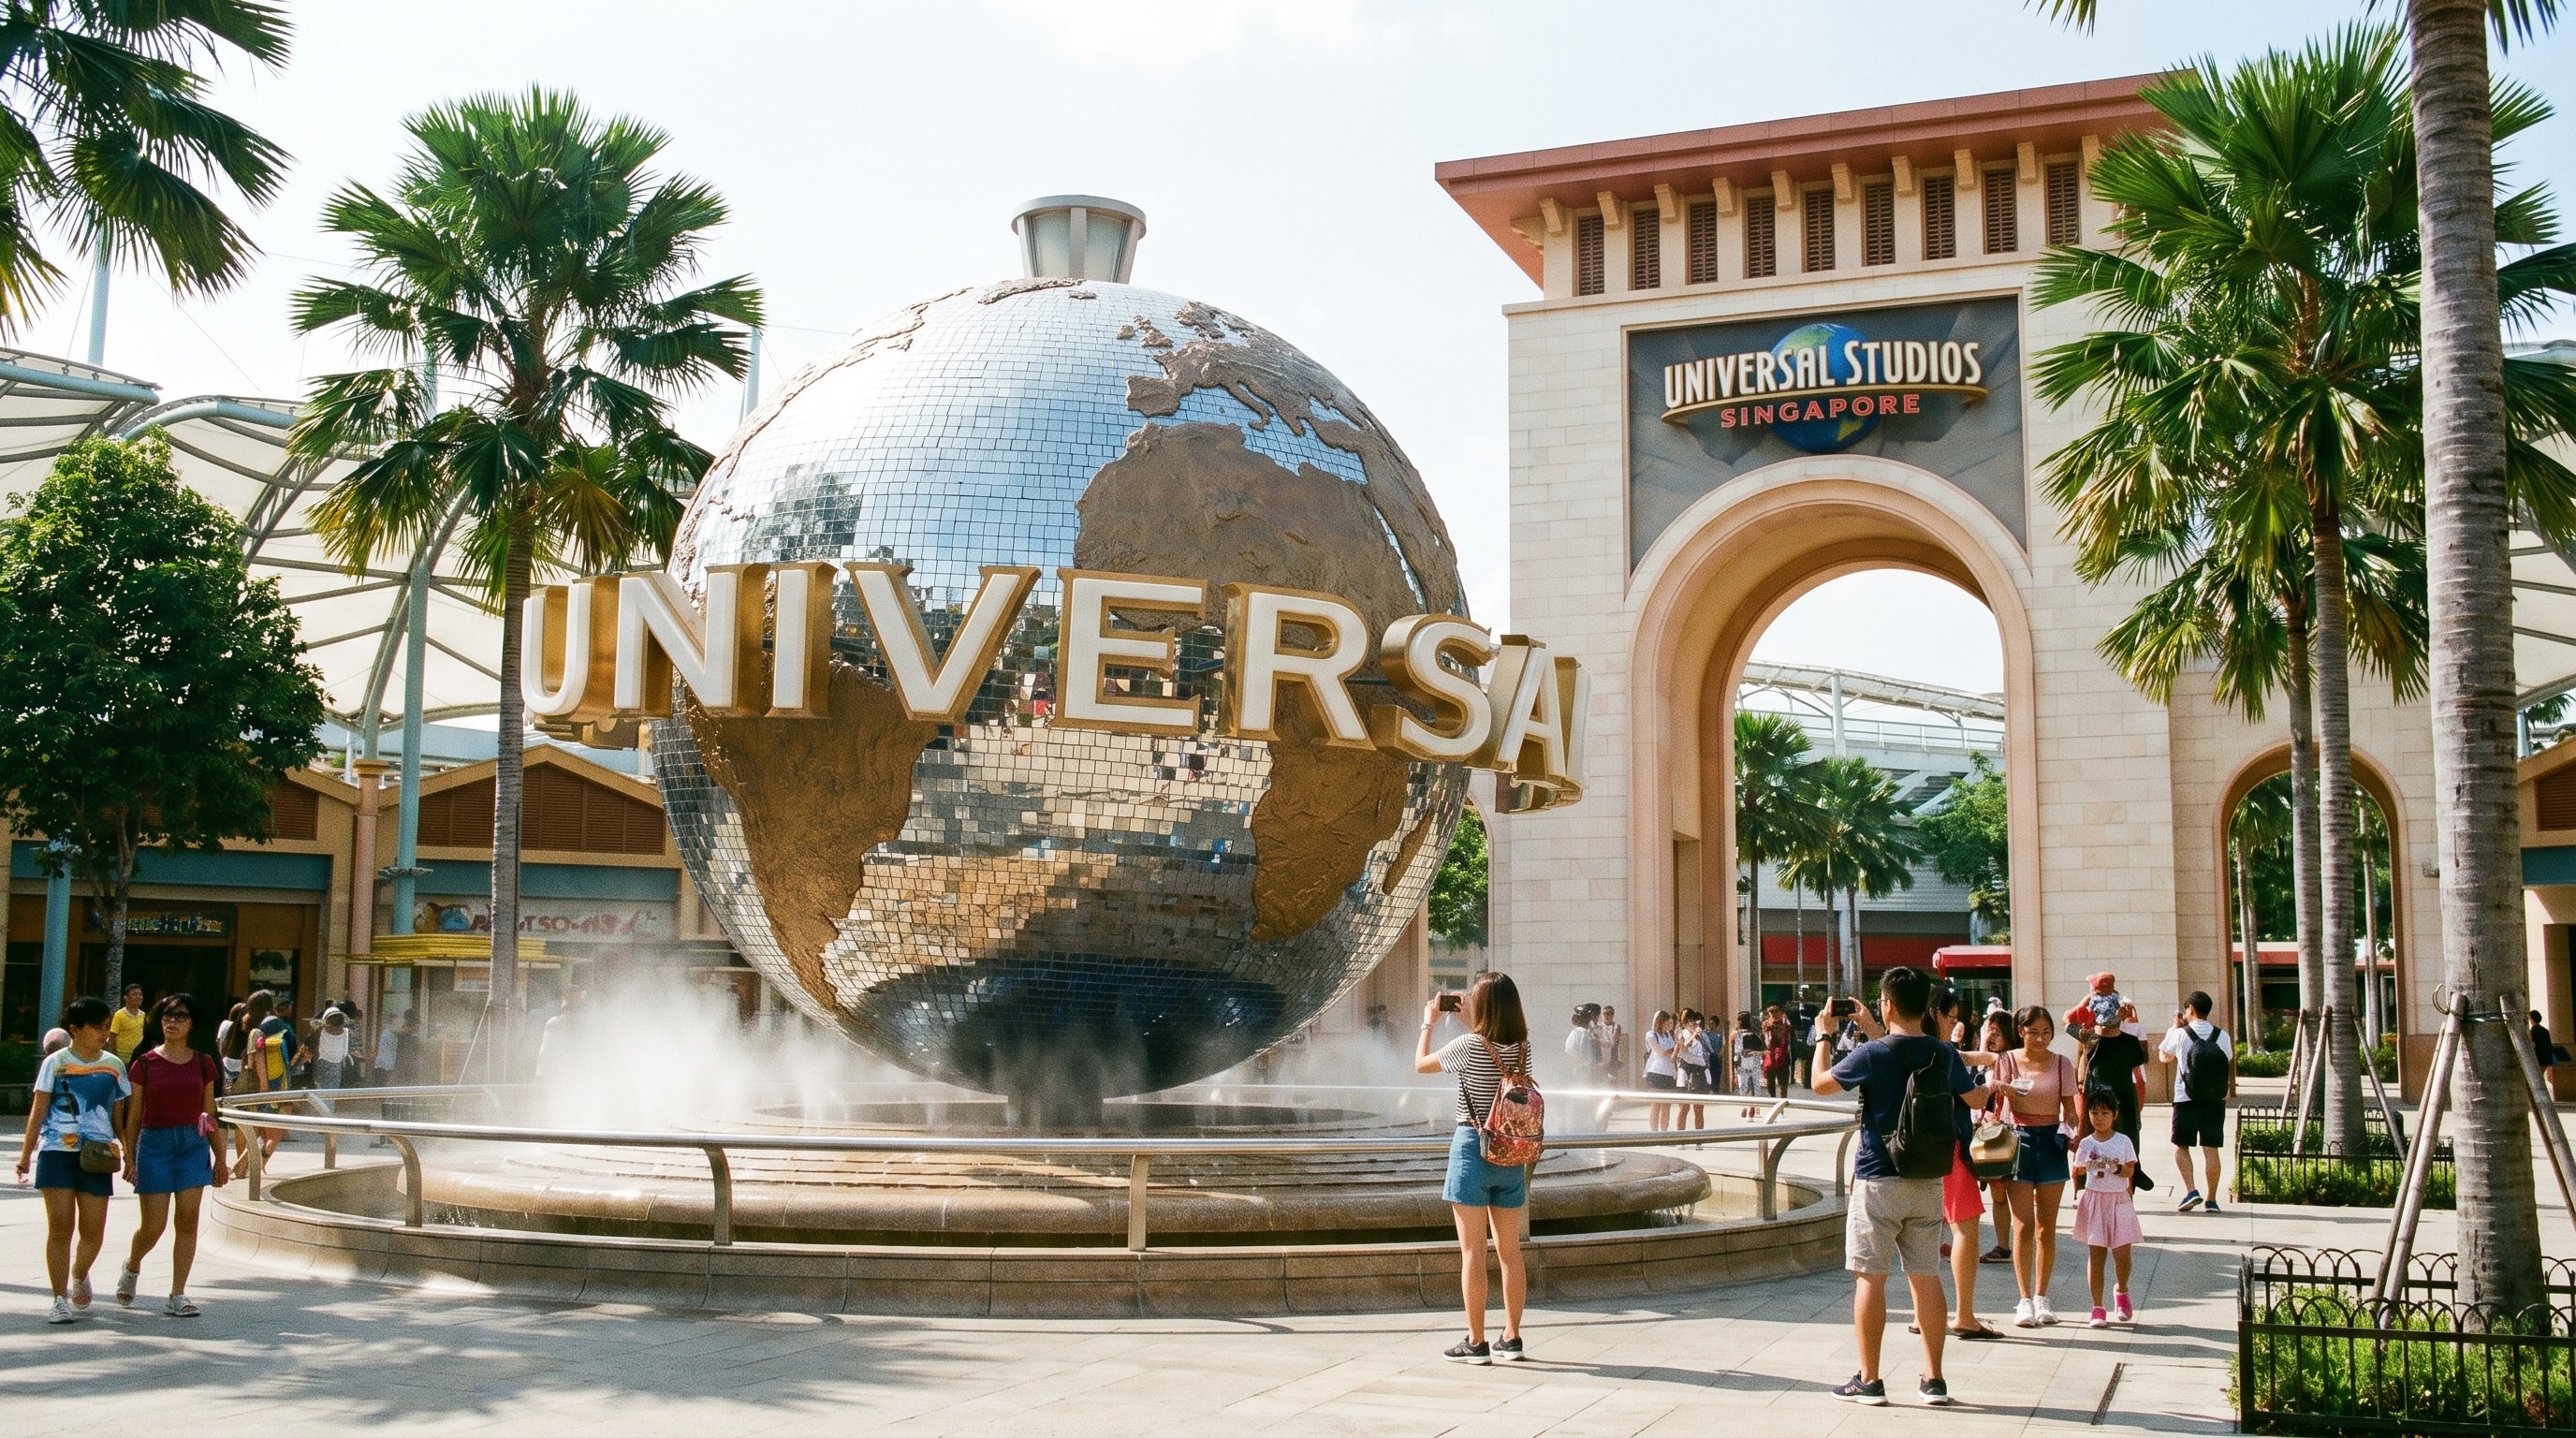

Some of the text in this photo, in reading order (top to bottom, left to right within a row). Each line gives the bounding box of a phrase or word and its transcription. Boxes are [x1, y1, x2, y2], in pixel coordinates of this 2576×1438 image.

[1664, 340, 1982, 409] UNIVERSAL STUDIOS
[1720, 393, 1920, 428] SINGAPORE
